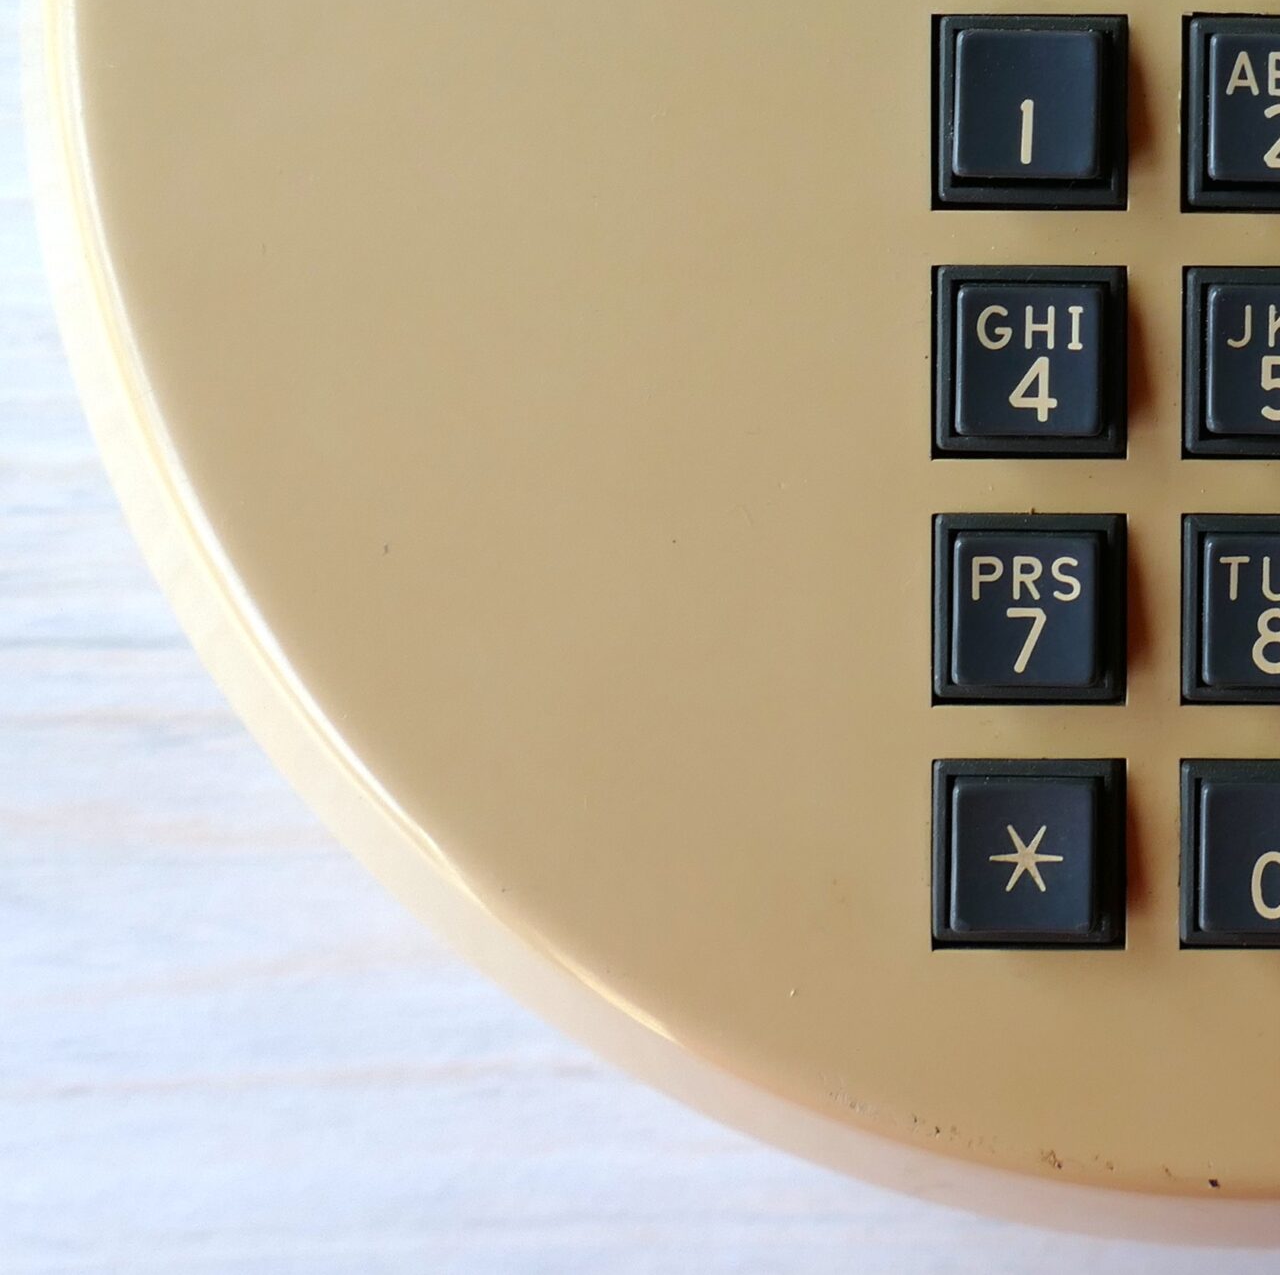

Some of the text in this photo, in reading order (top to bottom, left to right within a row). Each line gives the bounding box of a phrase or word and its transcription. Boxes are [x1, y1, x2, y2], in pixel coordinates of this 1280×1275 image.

[1020, 99, 1034, 165] 1
[976, 305, 1084, 351] GHI
[1008, 356, 1058, 423] 4
[972, 555, 1082, 602] PRS
[1006, 607, 1047, 674] 7
